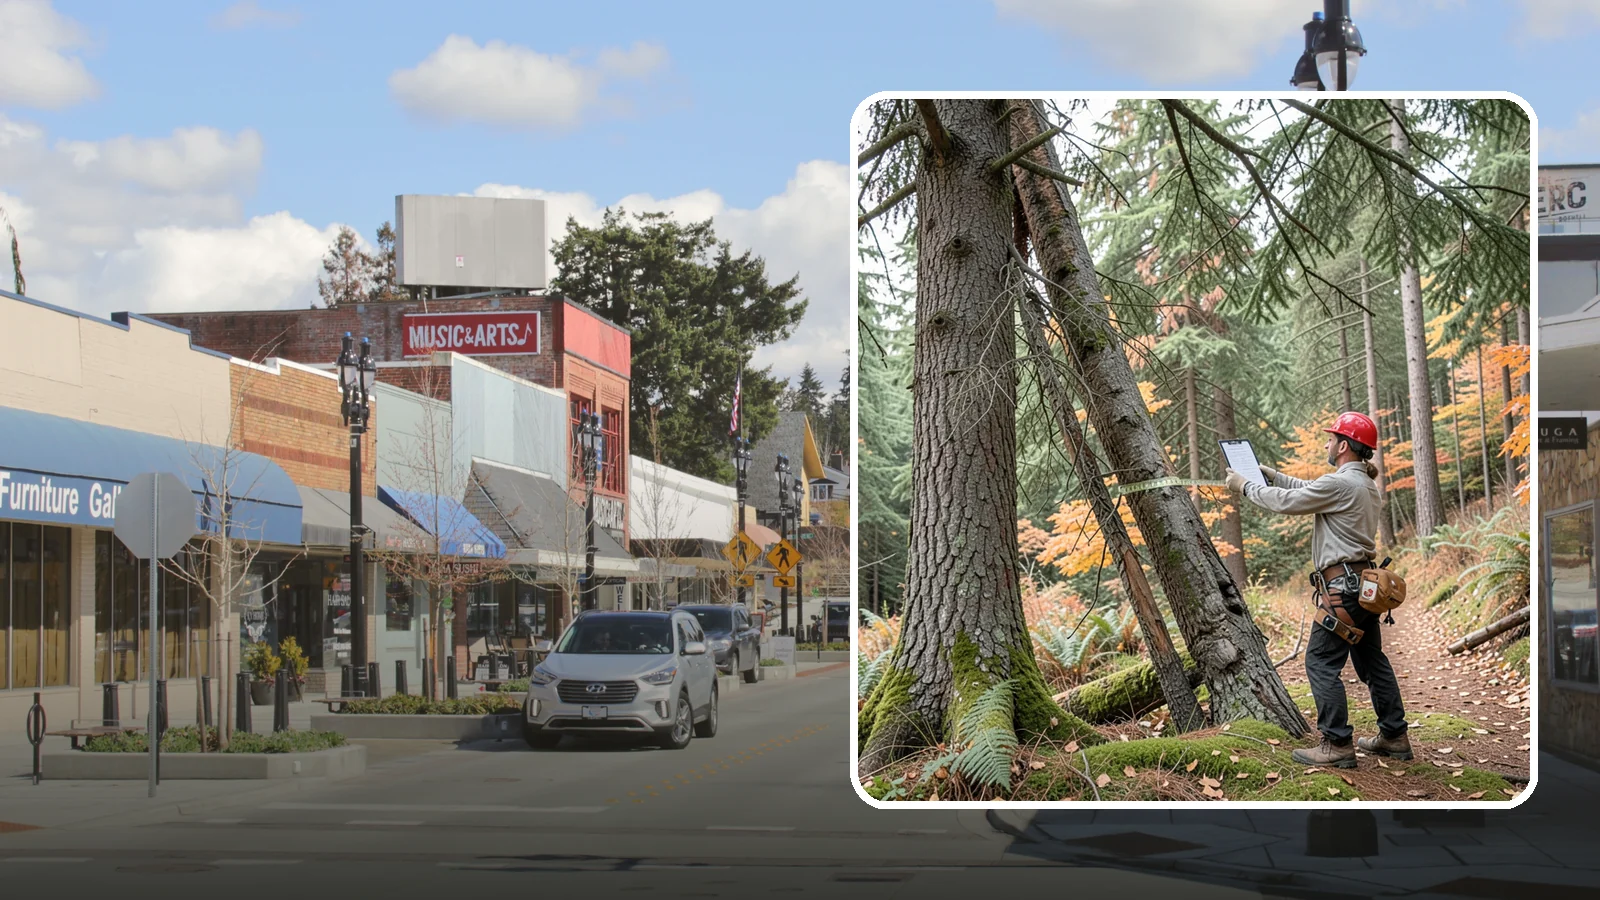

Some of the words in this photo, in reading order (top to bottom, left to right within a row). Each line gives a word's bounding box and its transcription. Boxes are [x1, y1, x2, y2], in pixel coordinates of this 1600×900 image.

[409, 322, 520, 349] MUSIC&ARTS
[1540, 427, 1578, 437] UGA
[1552, 436, 1579, 445] Framing
[0, 471, 79, 515] Furniture
